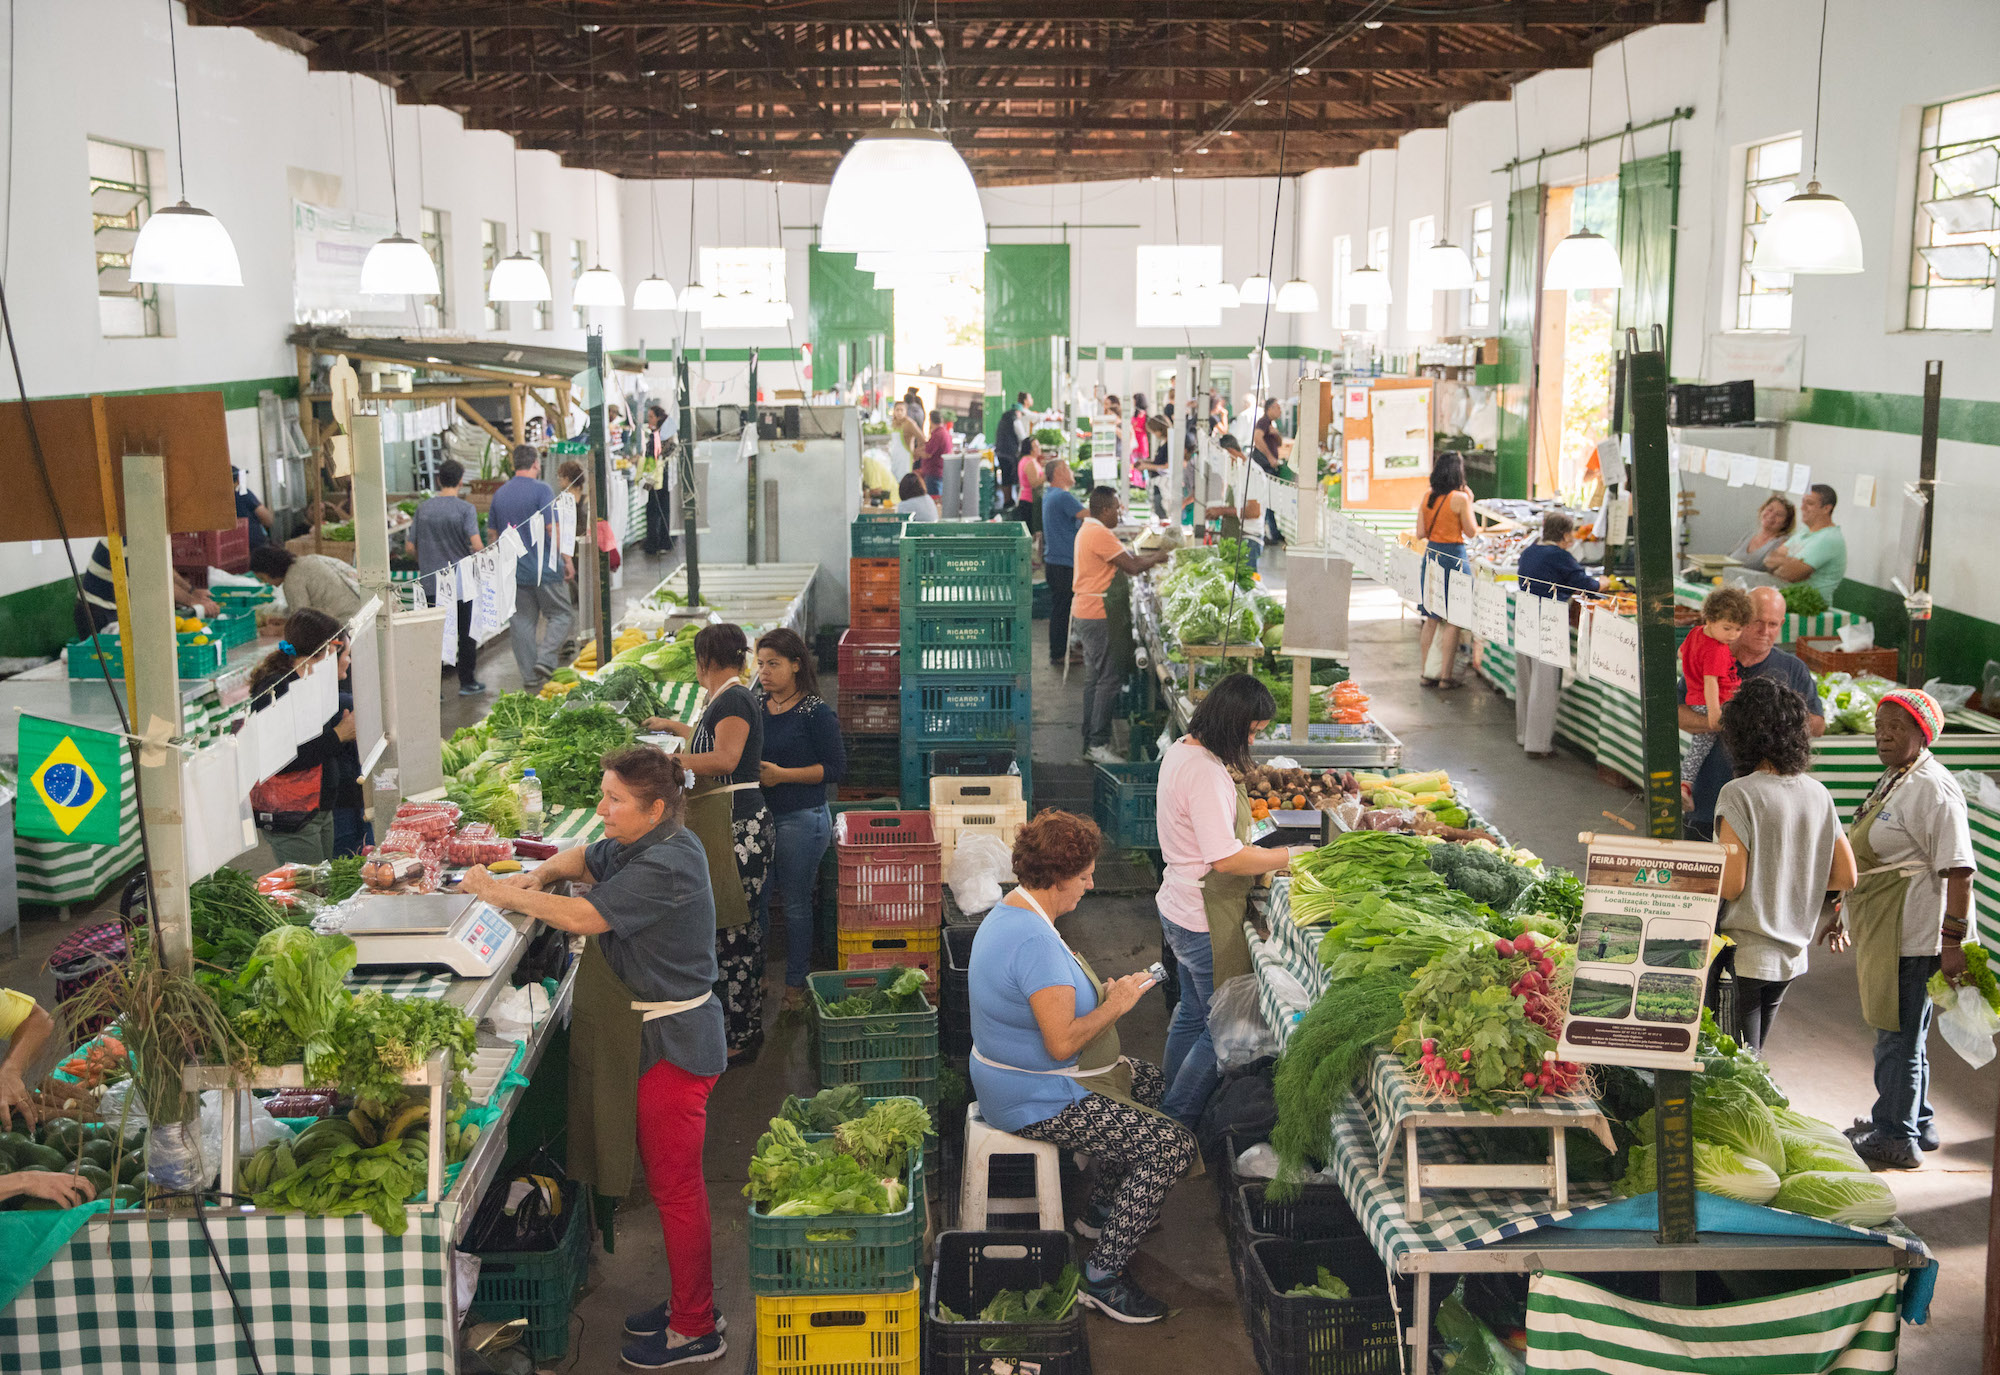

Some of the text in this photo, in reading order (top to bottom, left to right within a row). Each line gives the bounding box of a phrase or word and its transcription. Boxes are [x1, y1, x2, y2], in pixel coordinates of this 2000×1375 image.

[1591, 855, 1720, 873] FEIRA DO PRODUTOR ORGÂNICO
[1604, 896, 1650, 906] Localização:
[1617, 889, 1649, 897] Bernadete
[1650, 892, 1681, 900] Aparecida
[1691, 895, 1717, 903] Oliveira
